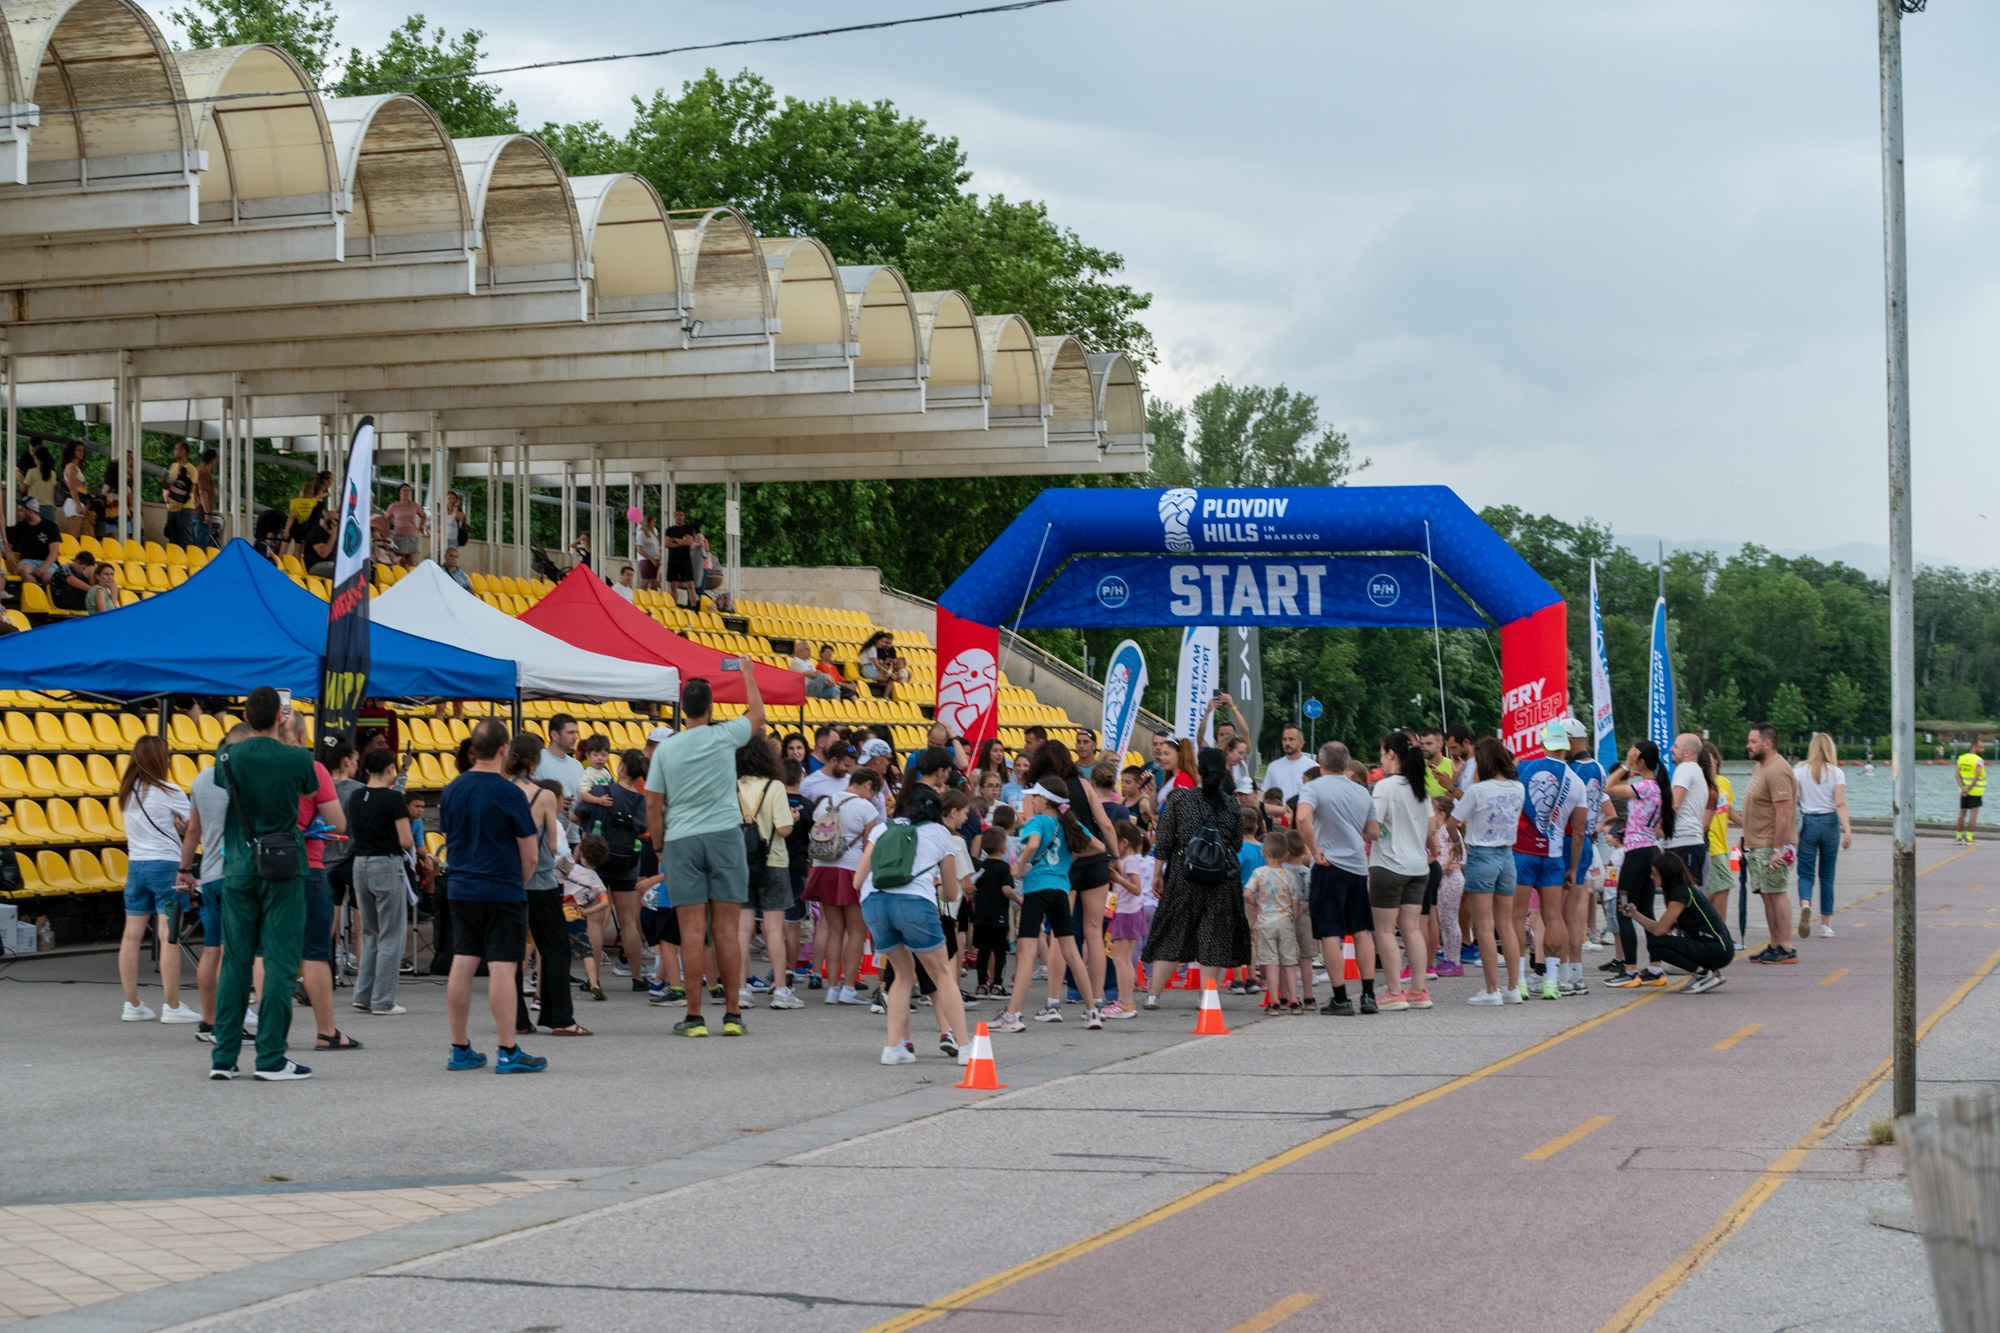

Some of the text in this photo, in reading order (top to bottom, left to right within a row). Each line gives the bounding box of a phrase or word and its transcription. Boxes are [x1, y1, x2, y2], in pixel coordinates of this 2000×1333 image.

[1203, 498, 1289, 518] PLOVDIV
[1203, 523, 1259, 542] HILLS
[1263, 525, 1275, 533] IN
[1264, 533, 1320, 541] MARKOVO
[1169, 564, 1327, 616] START
[1189, 643, 1201, 704] МЕТАЛИ
[1200, 645, 1211, 696] СПОРТ
[1657, 651, 1666, 705] СПОРТ
[1502, 677, 1546, 715] VERY
[1514, 692, 1563, 731] STEP
[1660, 707, 1669, 749] ЧИСТ
[1558, 775, 1571, 808] MATTERS
